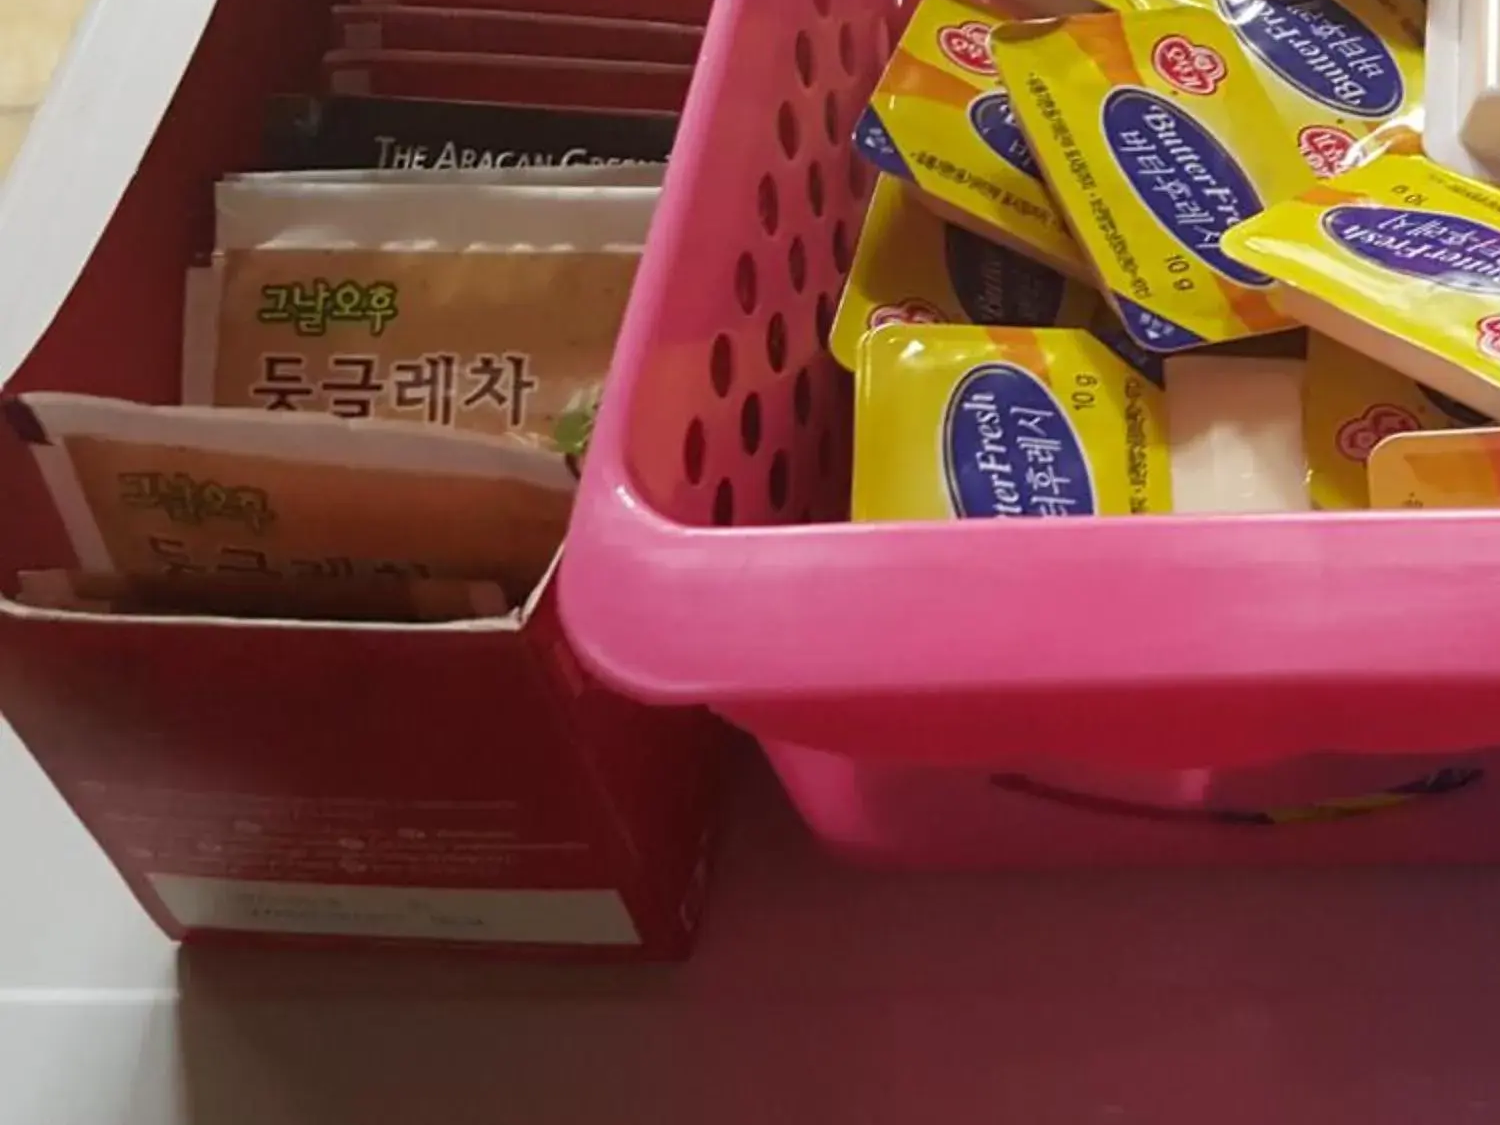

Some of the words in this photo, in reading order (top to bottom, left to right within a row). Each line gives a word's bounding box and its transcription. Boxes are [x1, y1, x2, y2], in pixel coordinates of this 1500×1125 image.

[373, 136, 426, 171] THE
[1142, 104, 1241, 226] ButterFre
[1118, 129, 1222, 249] 버터후레시
[1164, 254, 1190, 274] 10
[258, 277, 399, 337] 그날오후
[1071, 391, 1095, 411] 10
[1075, 374, 1098, 387] g
[963, 393, 1024, 515] terFresh
[1009, 406, 1077, 516] 터후레시
